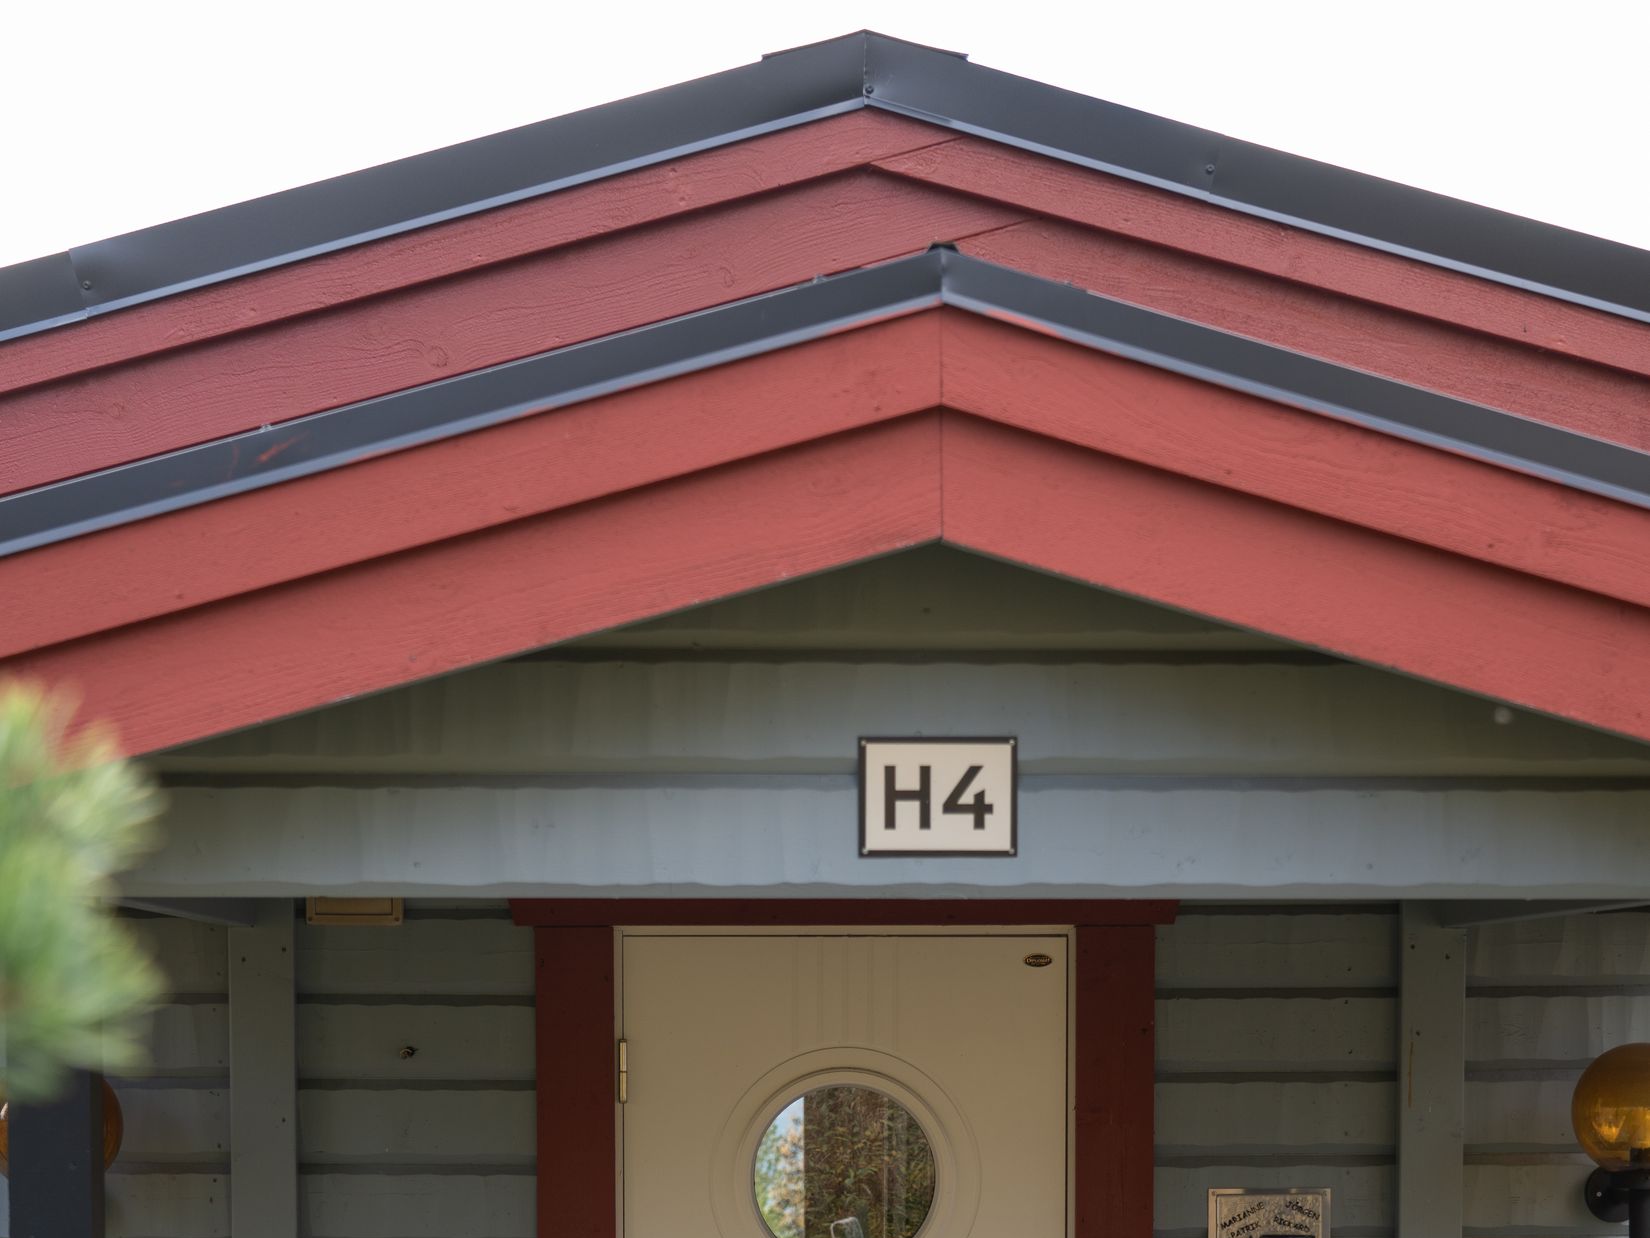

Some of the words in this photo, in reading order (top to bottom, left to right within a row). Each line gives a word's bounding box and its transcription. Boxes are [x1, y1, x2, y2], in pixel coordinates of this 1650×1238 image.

[884, 765, 994, 830] H4
[1220, 1201, 1265, 1231] MARIANNE
[1230, 1221, 1262, 1238] PATRIK
